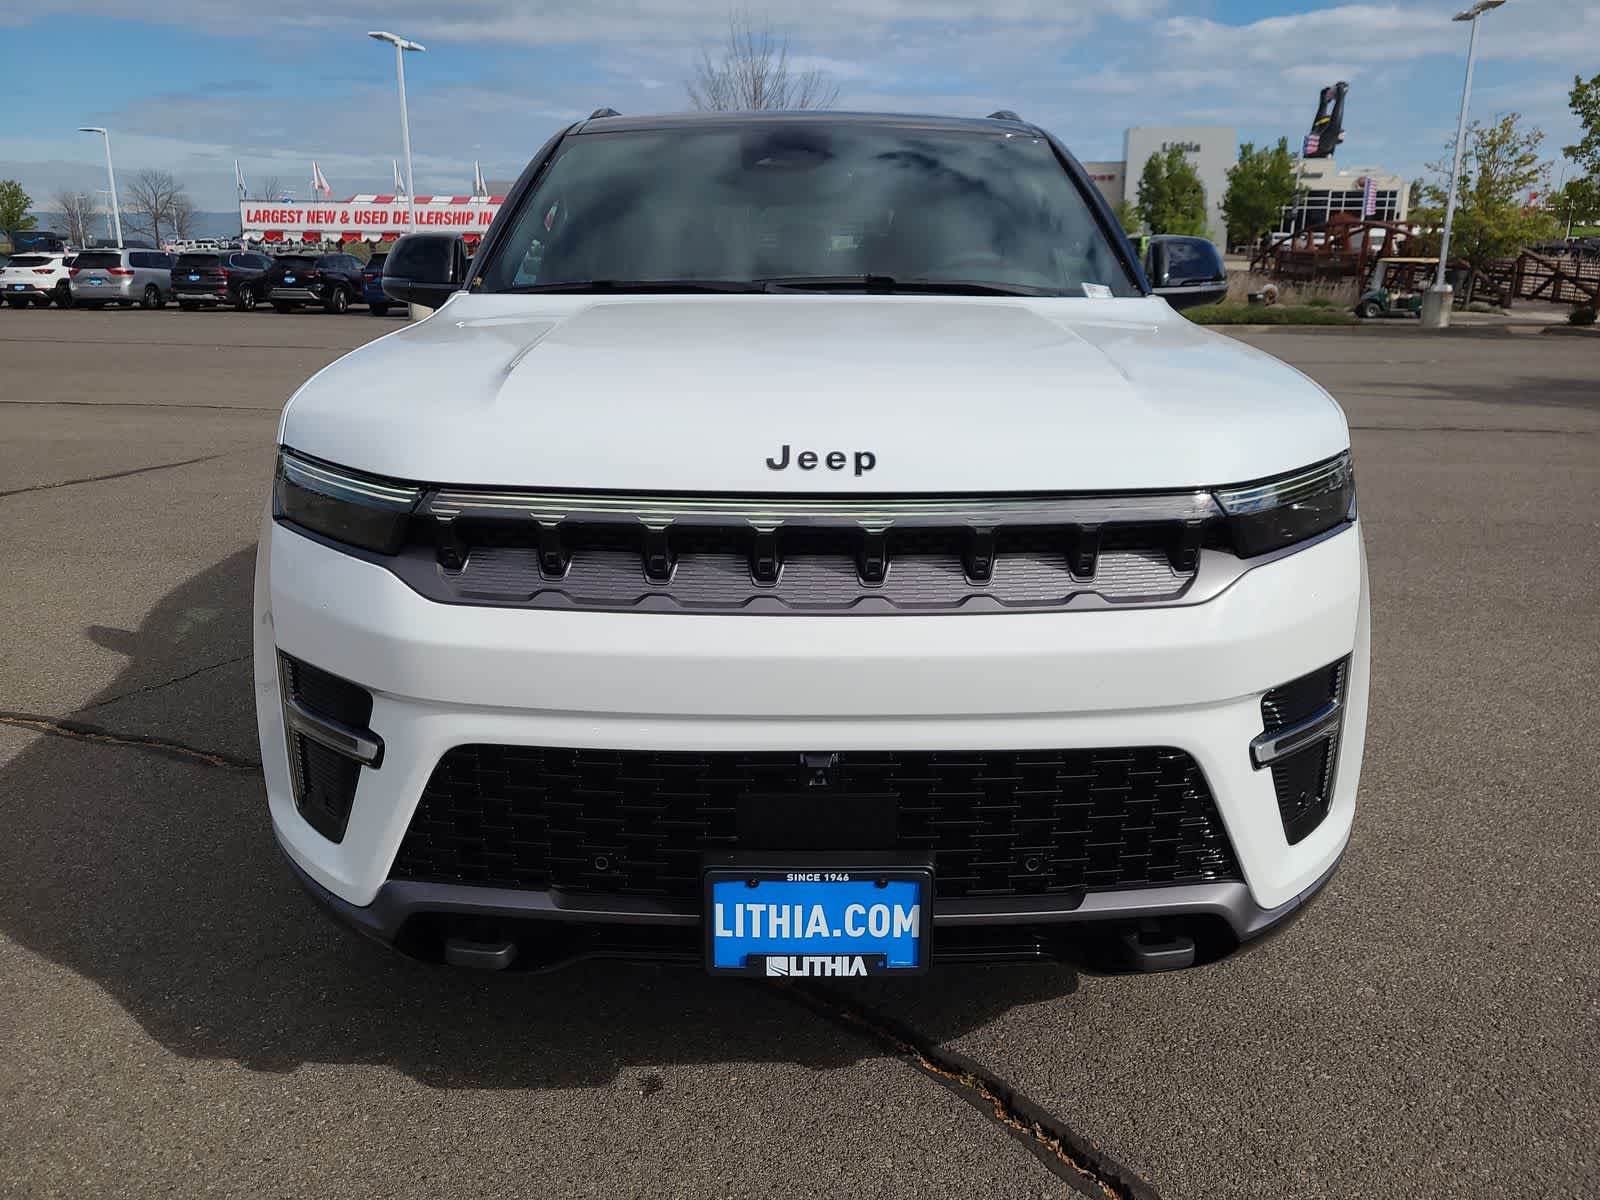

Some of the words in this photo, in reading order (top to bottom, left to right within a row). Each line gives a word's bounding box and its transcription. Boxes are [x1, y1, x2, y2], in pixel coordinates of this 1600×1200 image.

[246, 208, 303, 224] LARGEST
[306, 209, 336, 224] NEW
[340, 210, 350, 224] &
[354, 210, 389, 225] USED
[478, 212, 493, 225] IN
[766, 444, 876, 477] Jeep
[786, 873, 821, 882] SINCE
[824, 873, 850, 882] 1946
[715, 903, 920, 938] LITHIA.COM
[788, 956, 867, 976] LITHIA
